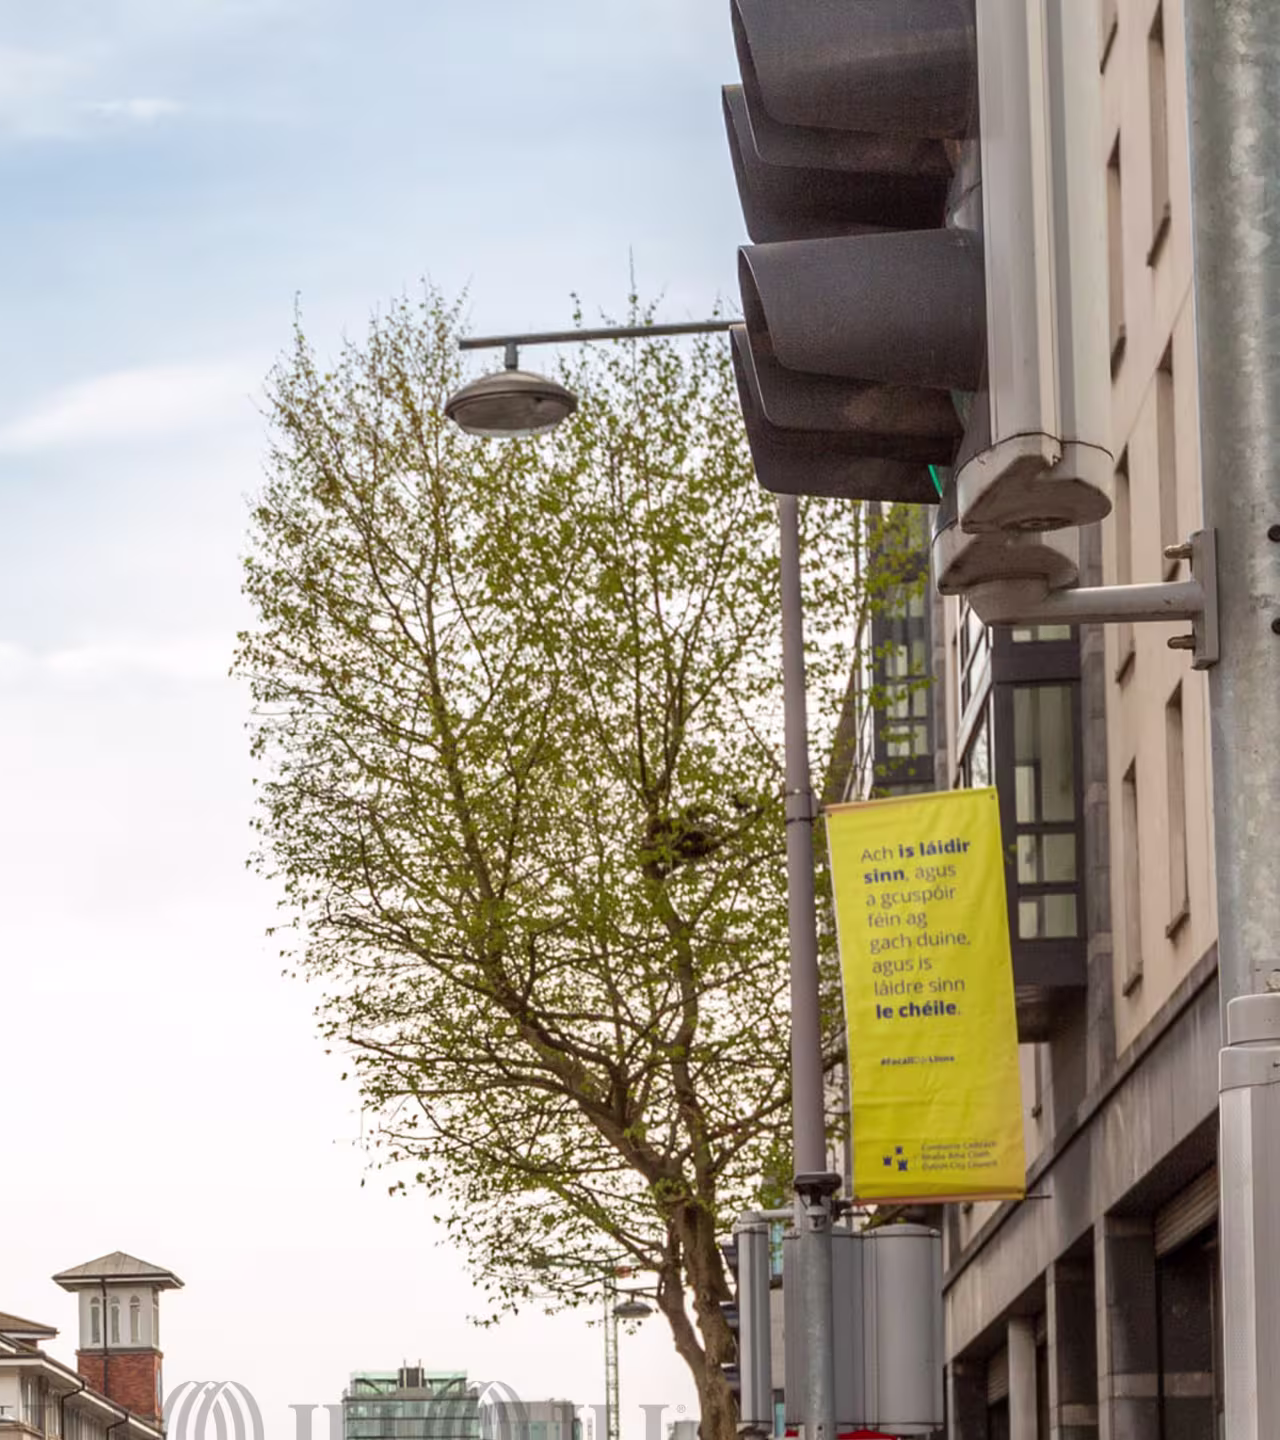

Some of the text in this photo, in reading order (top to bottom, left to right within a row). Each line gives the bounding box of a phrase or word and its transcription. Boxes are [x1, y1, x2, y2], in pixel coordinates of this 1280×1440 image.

[860, 838, 971, 863] Ach is láidir
[864, 864, 957, 884] sinn, agus
[866, 885, 957, 910] a gcuspóir
[868, 911, 928, 929] féin ag
[870, 933, 913, 955] gach
[872, 956, 933, 977] agus is
[874, 978, 966, 997] láidre sinn
[876, 1003, 894, 1020] le
